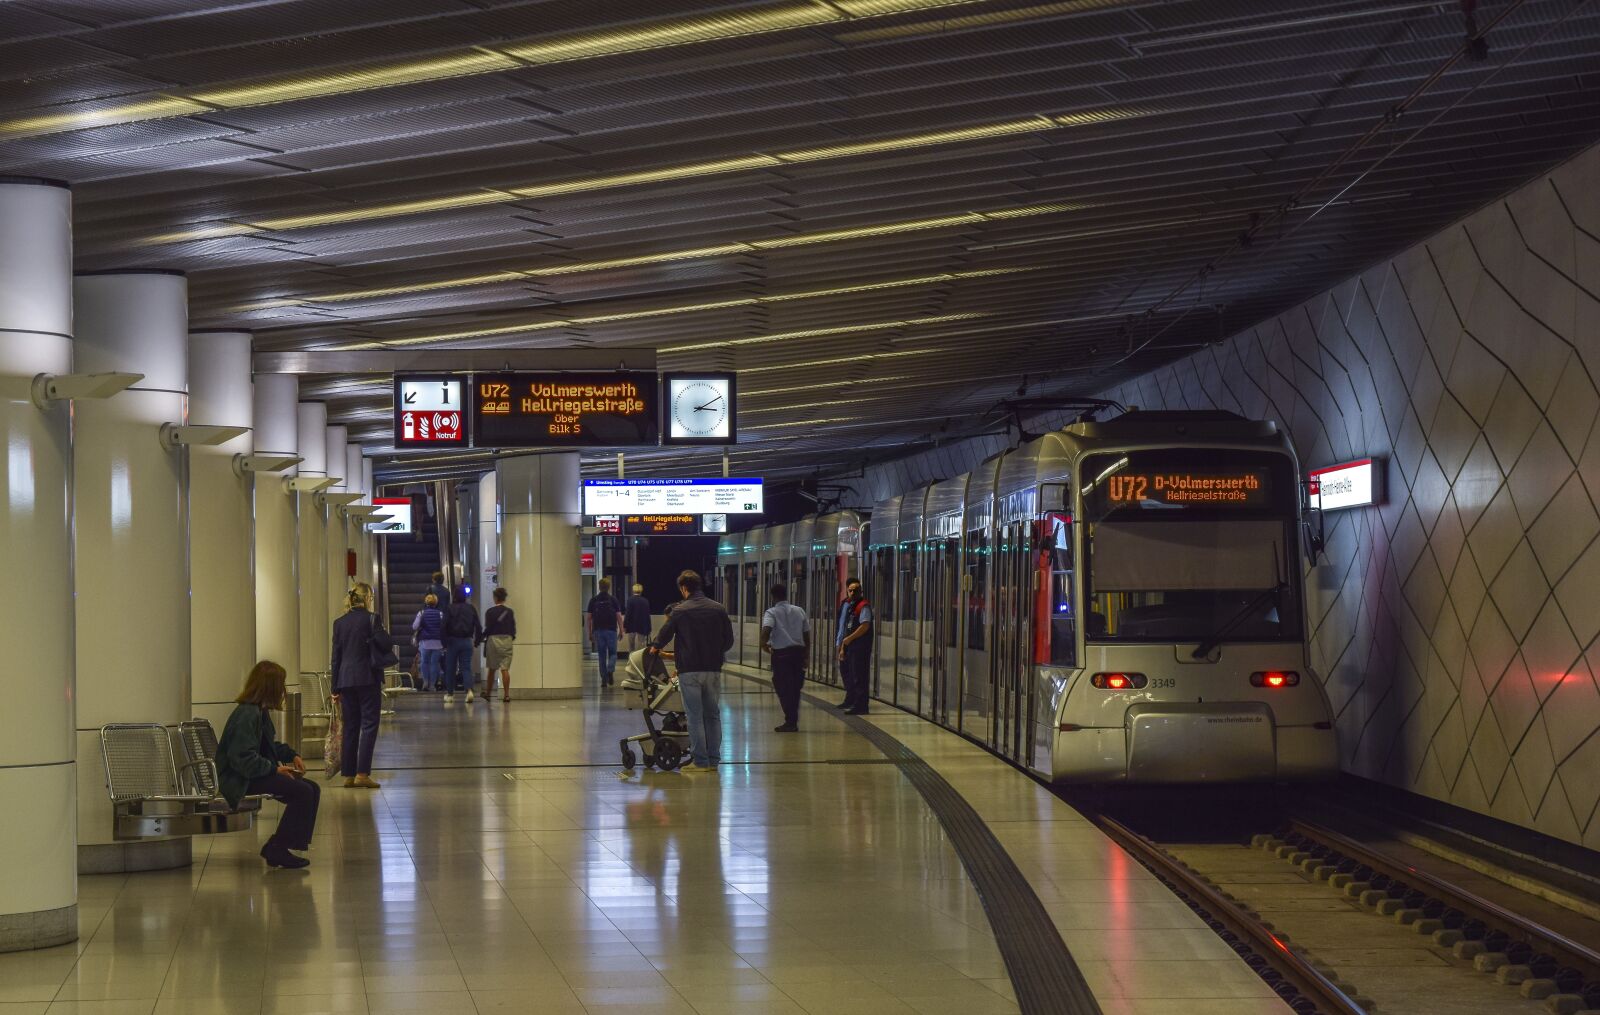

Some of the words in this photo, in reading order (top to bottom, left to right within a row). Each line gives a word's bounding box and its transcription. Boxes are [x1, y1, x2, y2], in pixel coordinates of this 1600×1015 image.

[481, 384, 510, 398] U72
[531, 383, 636, 397] Volmerswerth
[522, 398, 644, 414] Hellriegelstraße
[554, 413, 580, 423] über
[550, 424, 570, 434] Bilk
[573, 424, 581, 434] S
[435, 431, 457, 440] Notruf
[1154, 475, 1258, 490] D-Volmerswerth
[1109, 476, 1148, 501] U72
[1166, 490, 1246, 501] Hellriegelstraße
[643, 515, 693, 523] Hellriegelstraße
[1152, 679, 1176, 689] 3349
